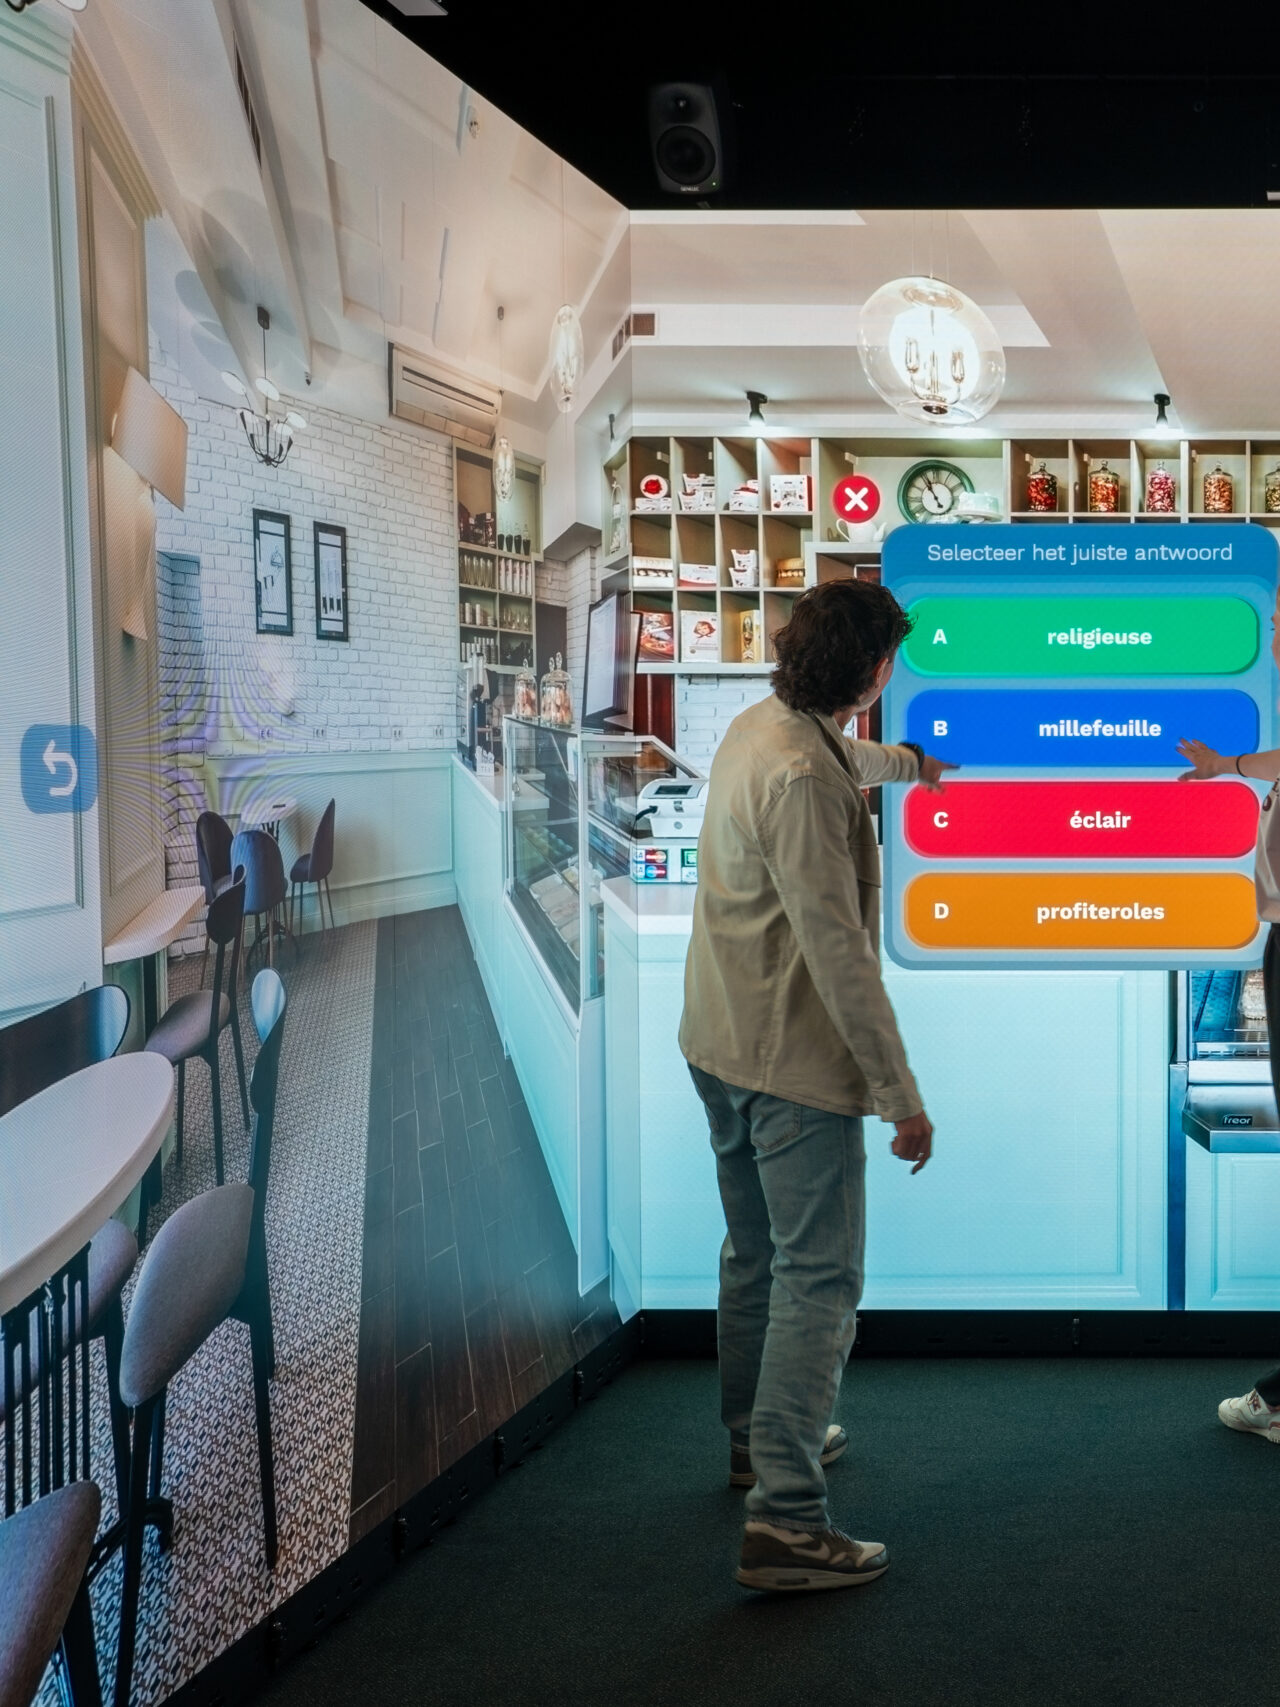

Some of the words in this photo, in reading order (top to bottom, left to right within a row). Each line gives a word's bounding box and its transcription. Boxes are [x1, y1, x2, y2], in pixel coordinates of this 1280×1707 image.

[927, 543, 1026, 562] Selecteer
[1032, 543, 1066, 561] het
[1071, 543, 1128, 566] juiste
[1135, 543, 1233, 562] antwoord
[932, 628, 948, 645] A
[1047, 628, 1153, 650] religieuse
[933, 720, 948, 737] B
[1038, 718, 1162, 738] millefeuille
[933, 811, 949, 829] C
[1069, 810, 1132, 830] éclair
[934, 902, 950, 920] D
[1036, 901, 1165, 924] profiteroles
